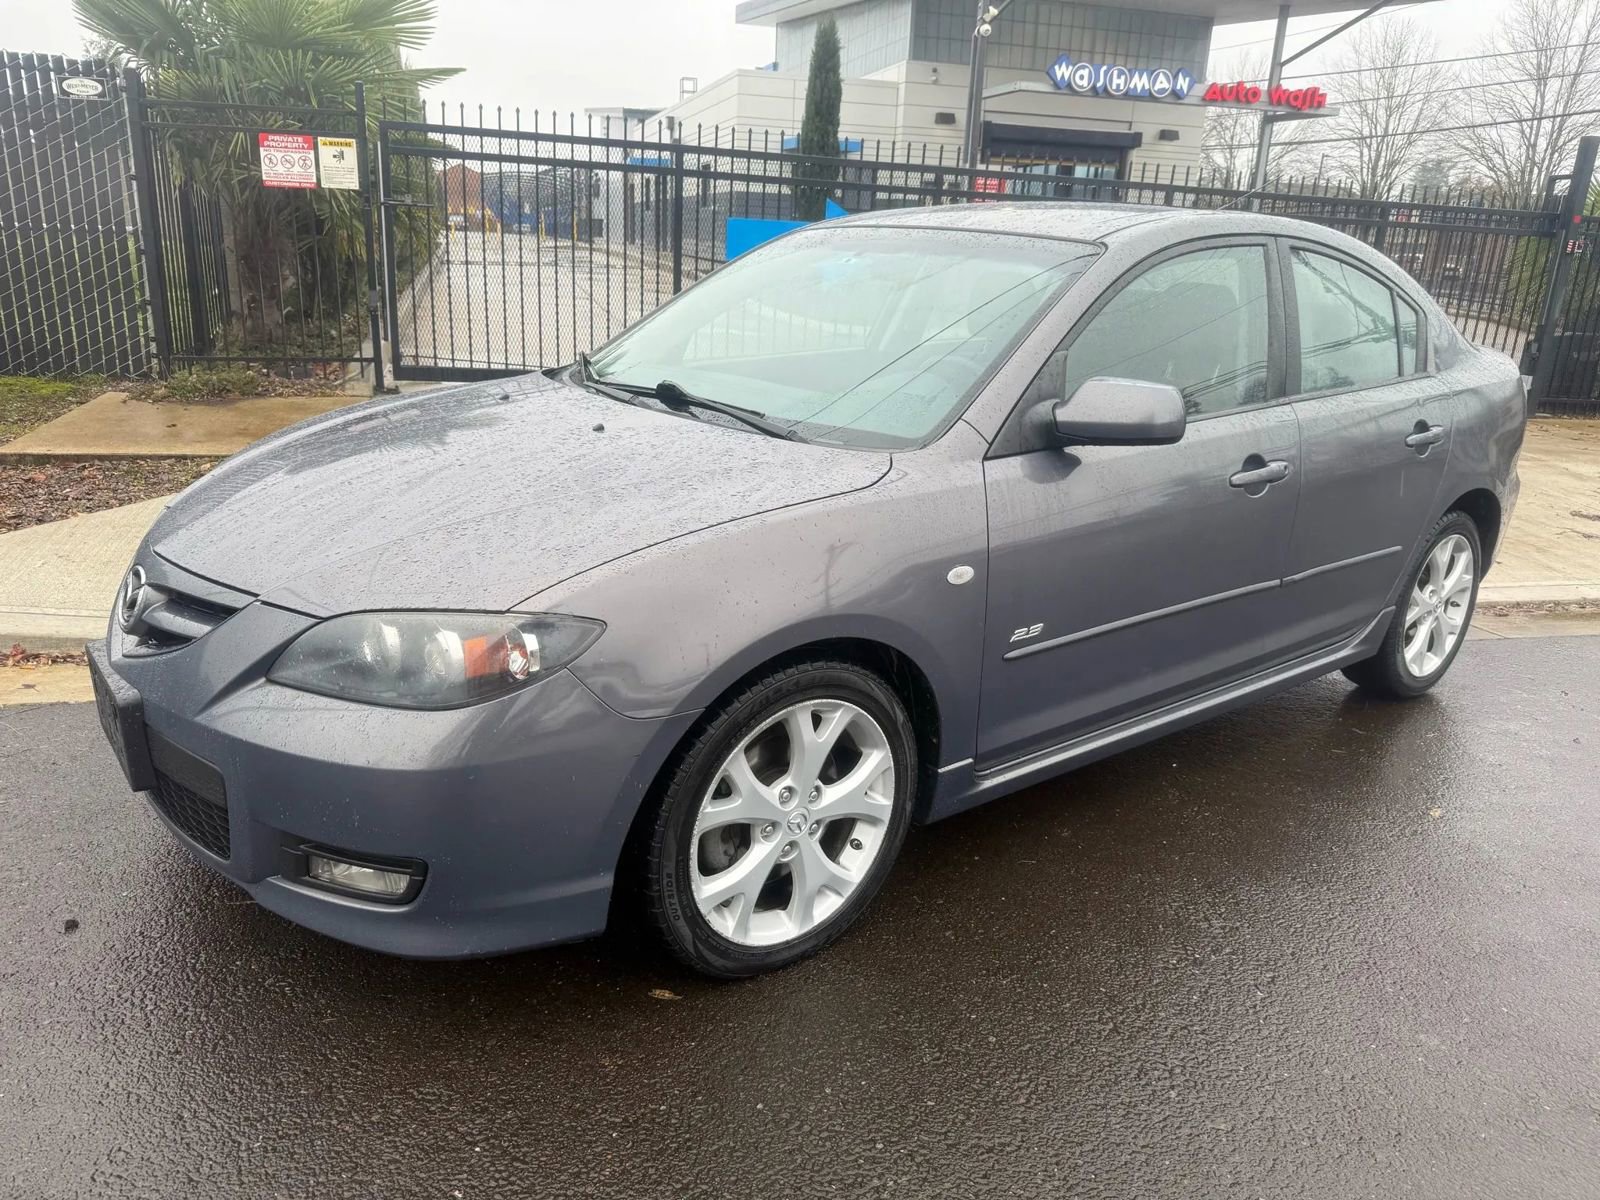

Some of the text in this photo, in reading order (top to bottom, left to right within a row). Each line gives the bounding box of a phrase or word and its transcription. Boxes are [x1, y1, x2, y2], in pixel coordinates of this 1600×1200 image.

[1203, 81, 1262, 104] Auto
[263, 140, 309, 150] PROPERTY
[268, 135, 304, 143] PRIVATE
[665, 872, 681, 921] OUTSIDE
